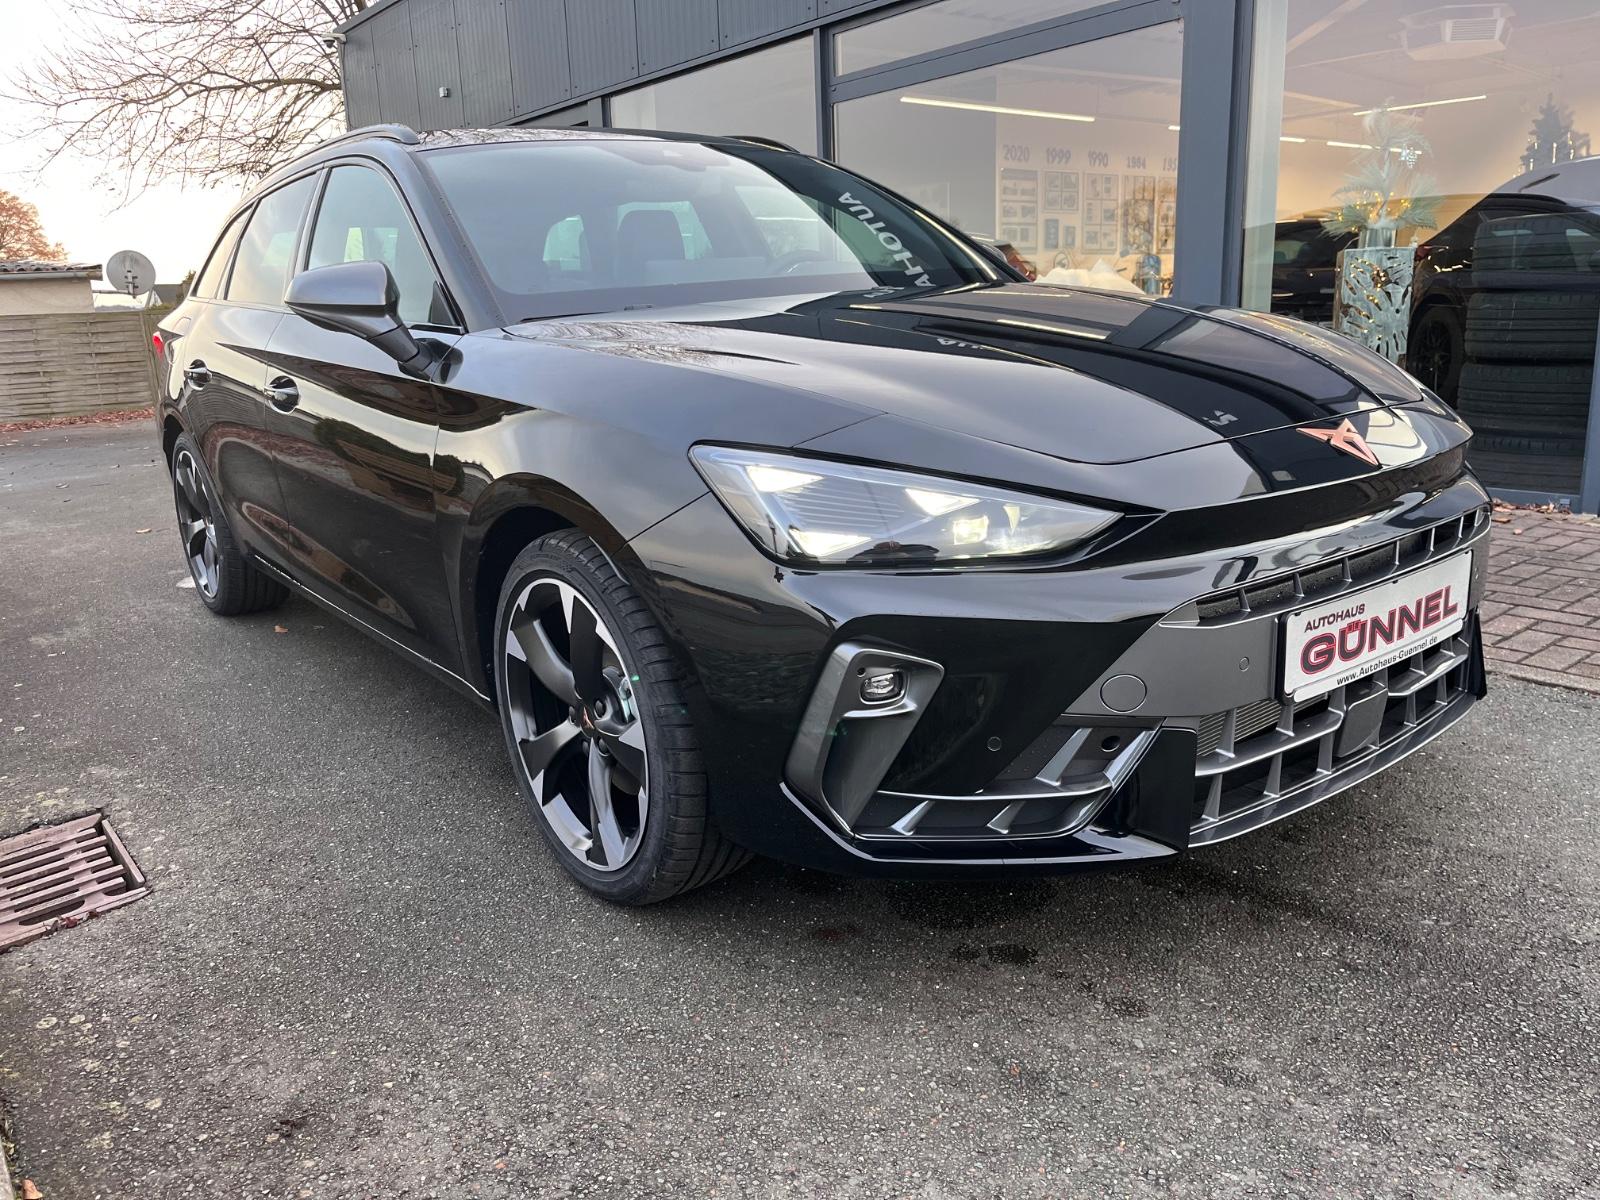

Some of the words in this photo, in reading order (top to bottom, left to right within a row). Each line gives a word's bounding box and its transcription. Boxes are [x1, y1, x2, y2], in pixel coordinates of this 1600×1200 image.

[1002, 144, 1031, 163] 2020
[1046, 147, 1072, 165] 1999
[1087, 150, 1109, 169] 1990
[1300, 584, 1459, 676] GÜNNEL
[1304, 603, 1366, 633] AUTOHAUS
[1335, 634, 1438, 686] www.Autohaus-Guennel.de
